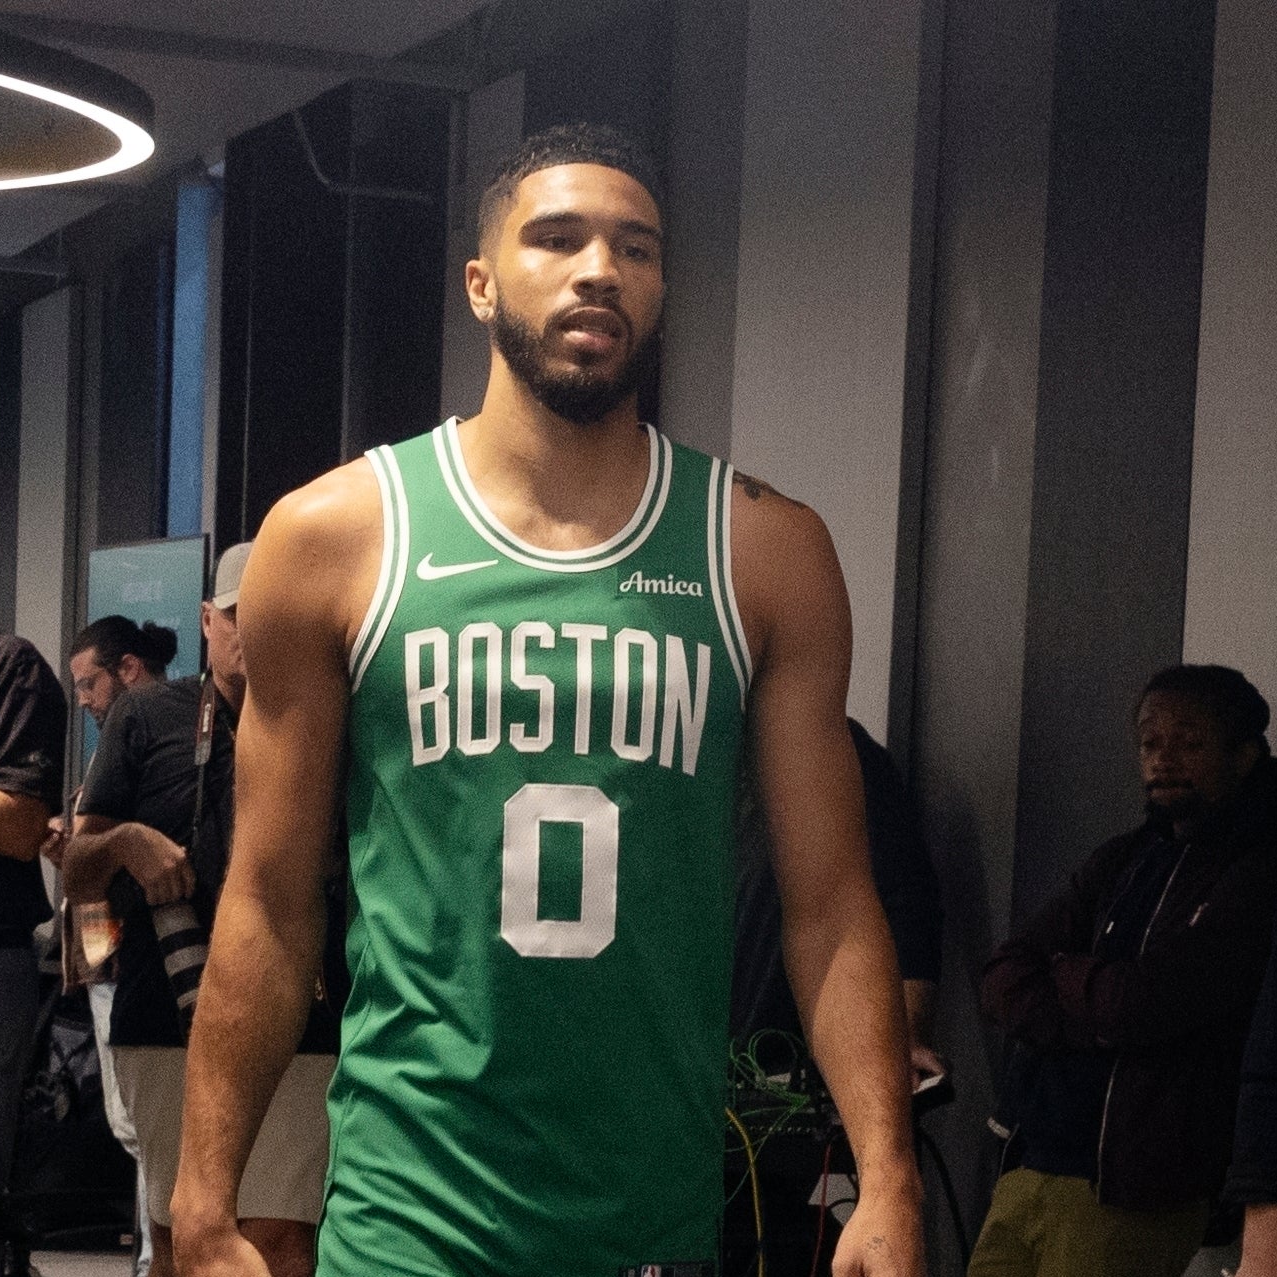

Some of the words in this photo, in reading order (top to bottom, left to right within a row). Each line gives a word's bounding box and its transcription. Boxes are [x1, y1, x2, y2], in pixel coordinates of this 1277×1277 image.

[619, 570, 704, 598] Amica
[404, 621, 712, 777] BOSTON
[500, 783, 620, 959] 0
